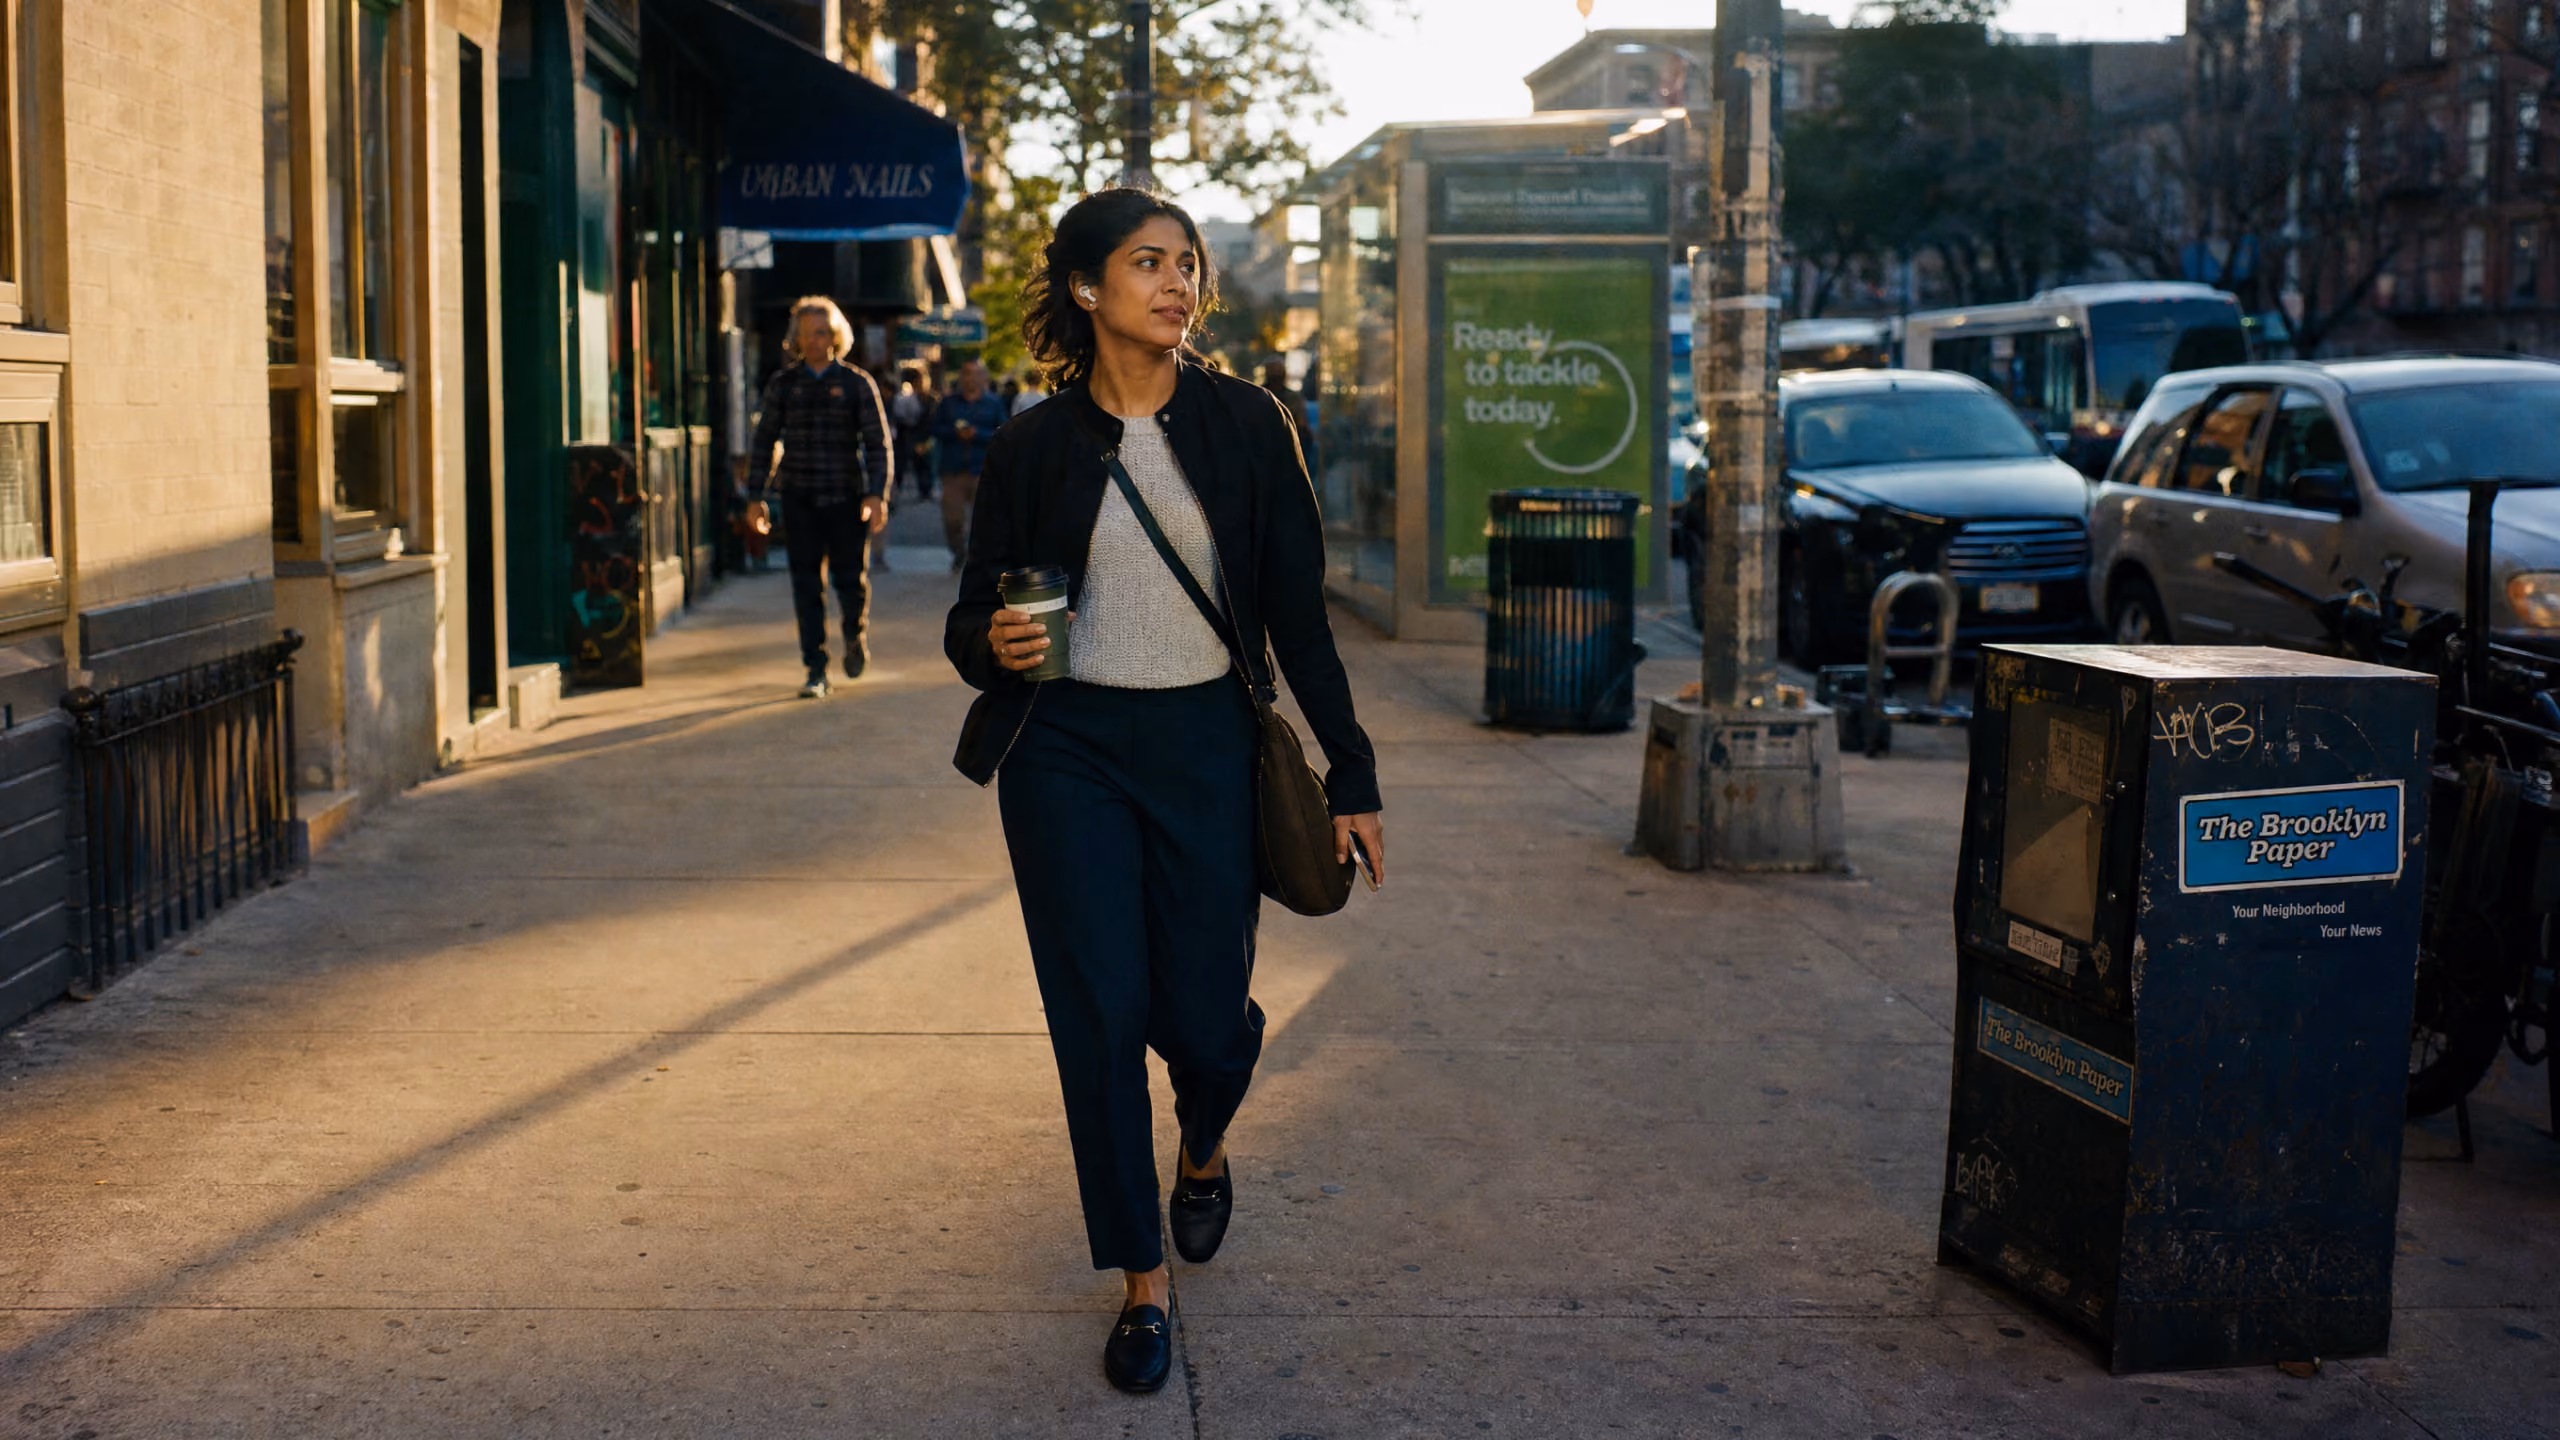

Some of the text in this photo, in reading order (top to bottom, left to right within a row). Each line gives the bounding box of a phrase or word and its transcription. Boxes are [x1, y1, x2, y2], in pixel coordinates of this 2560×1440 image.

[742, 163, 934, 199] URBAN NAILS
[1453, 321, 1552, 358] Ready
[1464, 355, 1601, 386] to tackle
[1464, 395, 1560, 430] today.
[2198, 807, 2388, 842] The Brooklyn
[2245, 838, 2336, 868] Paper
[2232, 901, 2345, 918] Your Neighborhood
[2320, 923, 2382, 938] Your News
[1987, 1015, 2124, 1097] The Brooklyn Paper
